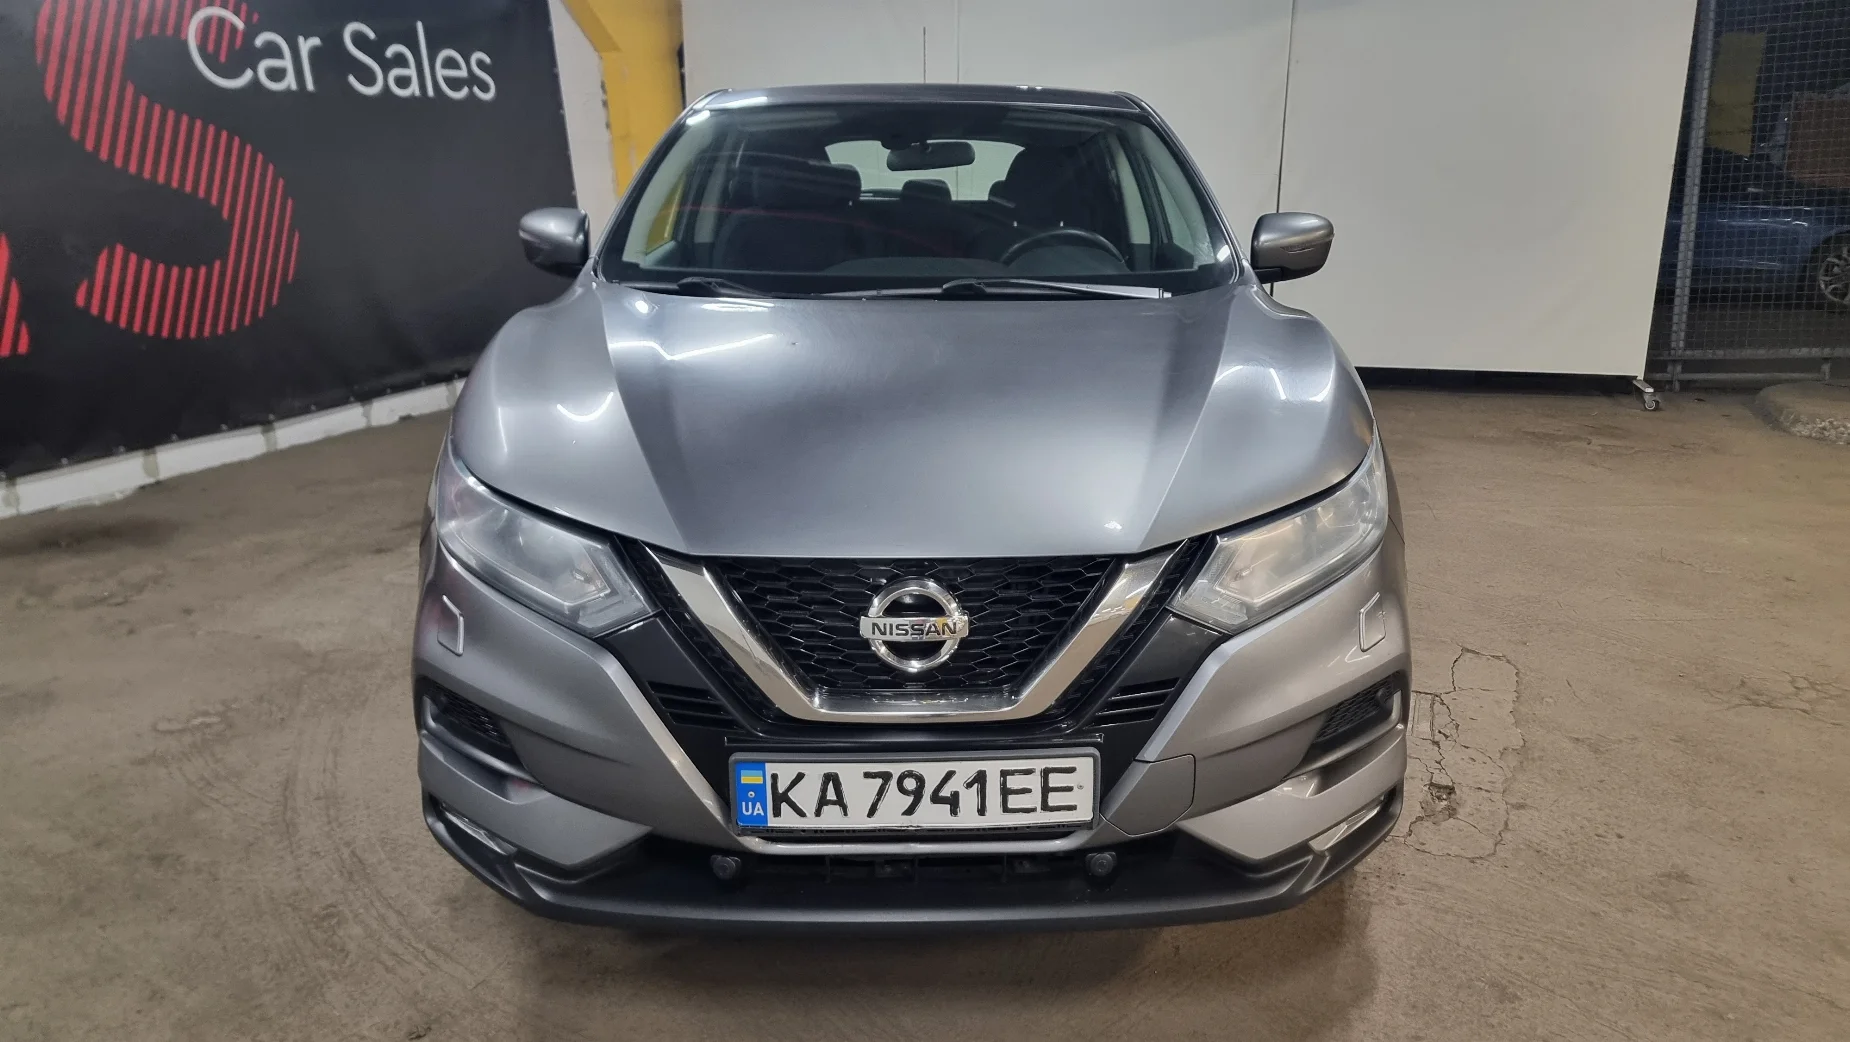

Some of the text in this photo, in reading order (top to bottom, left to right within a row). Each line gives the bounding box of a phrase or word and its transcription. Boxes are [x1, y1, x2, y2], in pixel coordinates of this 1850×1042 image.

[187, 6, 496, 101] Car Sales
[871, 622, 957, 636] NISSAN
[741, 802, 765, 816] UA
